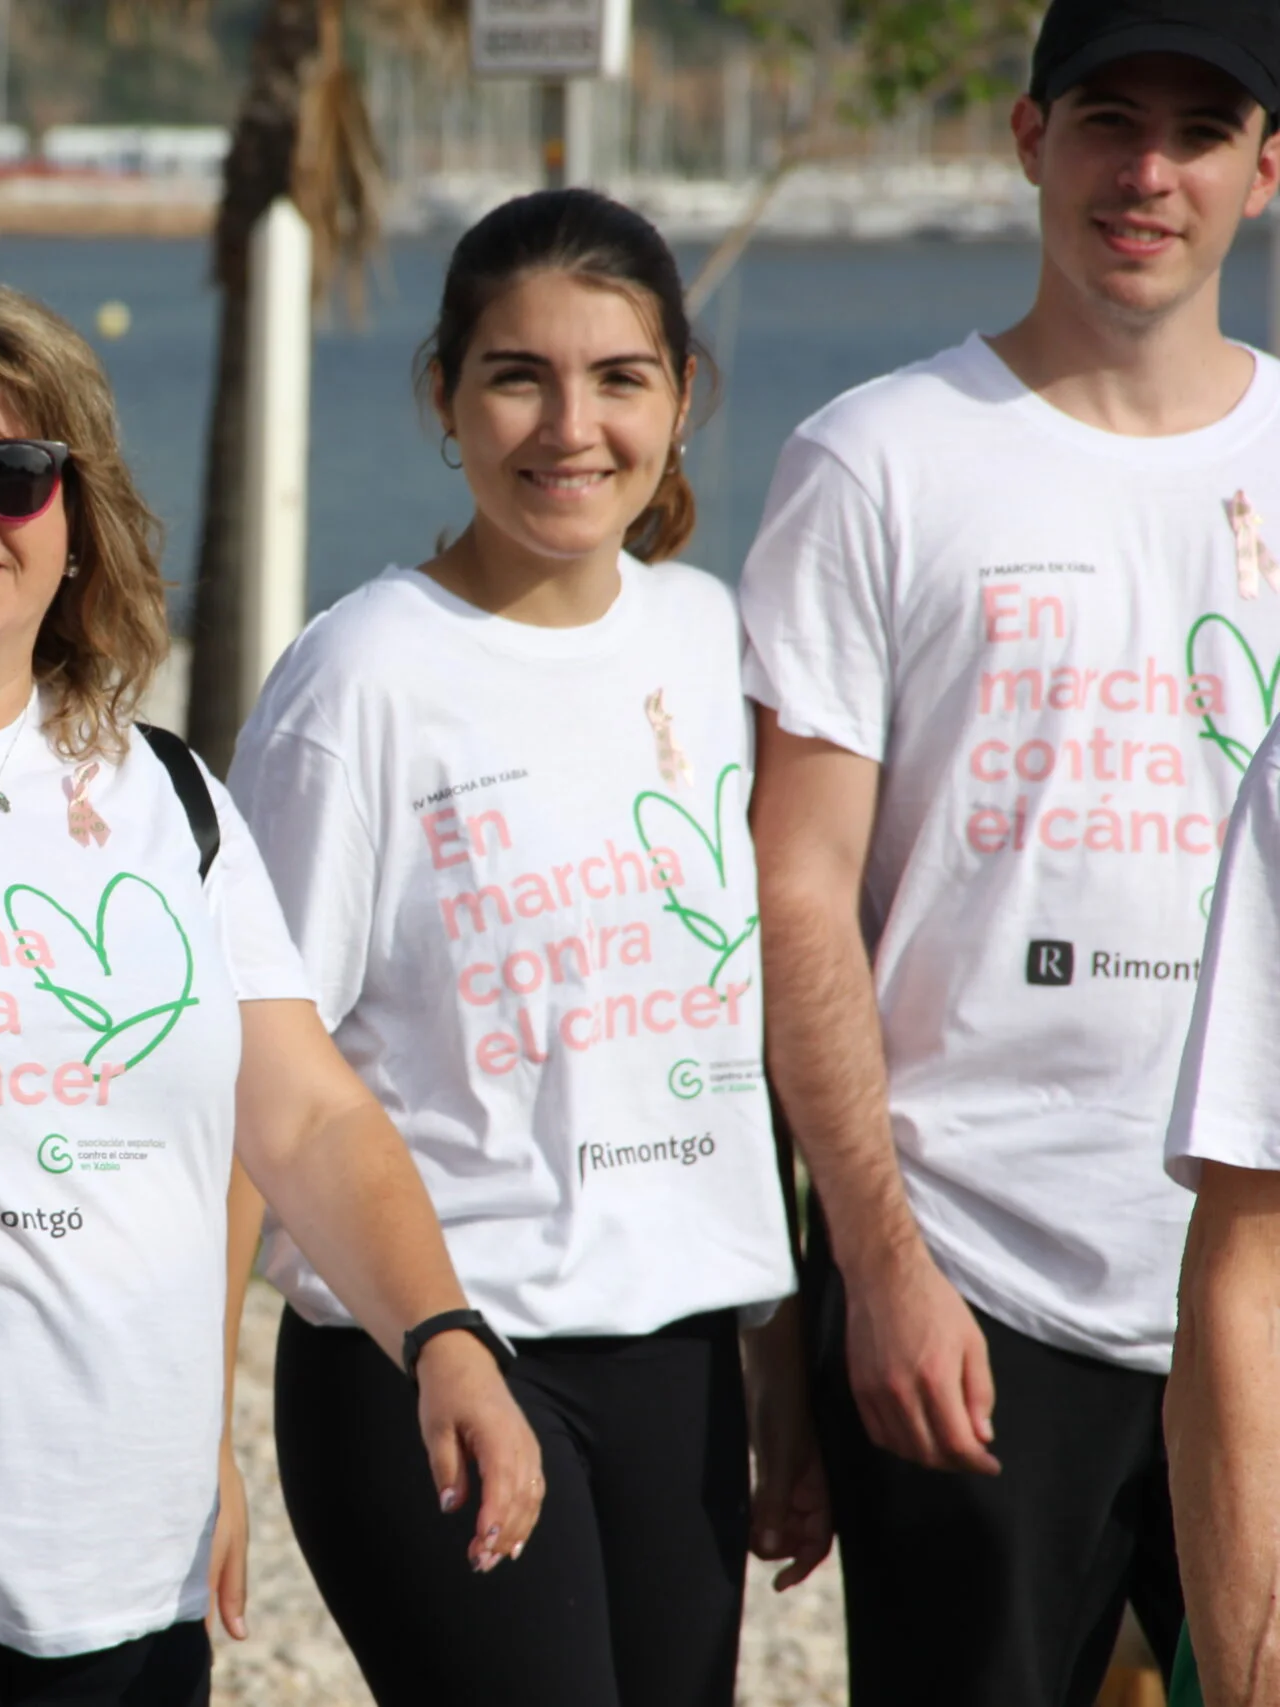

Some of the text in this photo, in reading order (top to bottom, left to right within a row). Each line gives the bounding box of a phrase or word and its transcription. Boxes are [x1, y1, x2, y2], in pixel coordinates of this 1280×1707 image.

[981, 583, 1065, 643] En
[978, 657, 1227, 716] marcha
[427, 779, 479, 805] MARCHA
[480, 775, 498, 788] EN
[421, 806, 512, 871] En
[966, 795, 1029, 854] el
[439, 839, 685, 941] marcha
[1038, 945, 1064, 979] R
[475, 981, 750, 1076] el cncer
[78, 1151, 107, 1160] contra
[590, 1131, 716, 1170] Rimontgó
